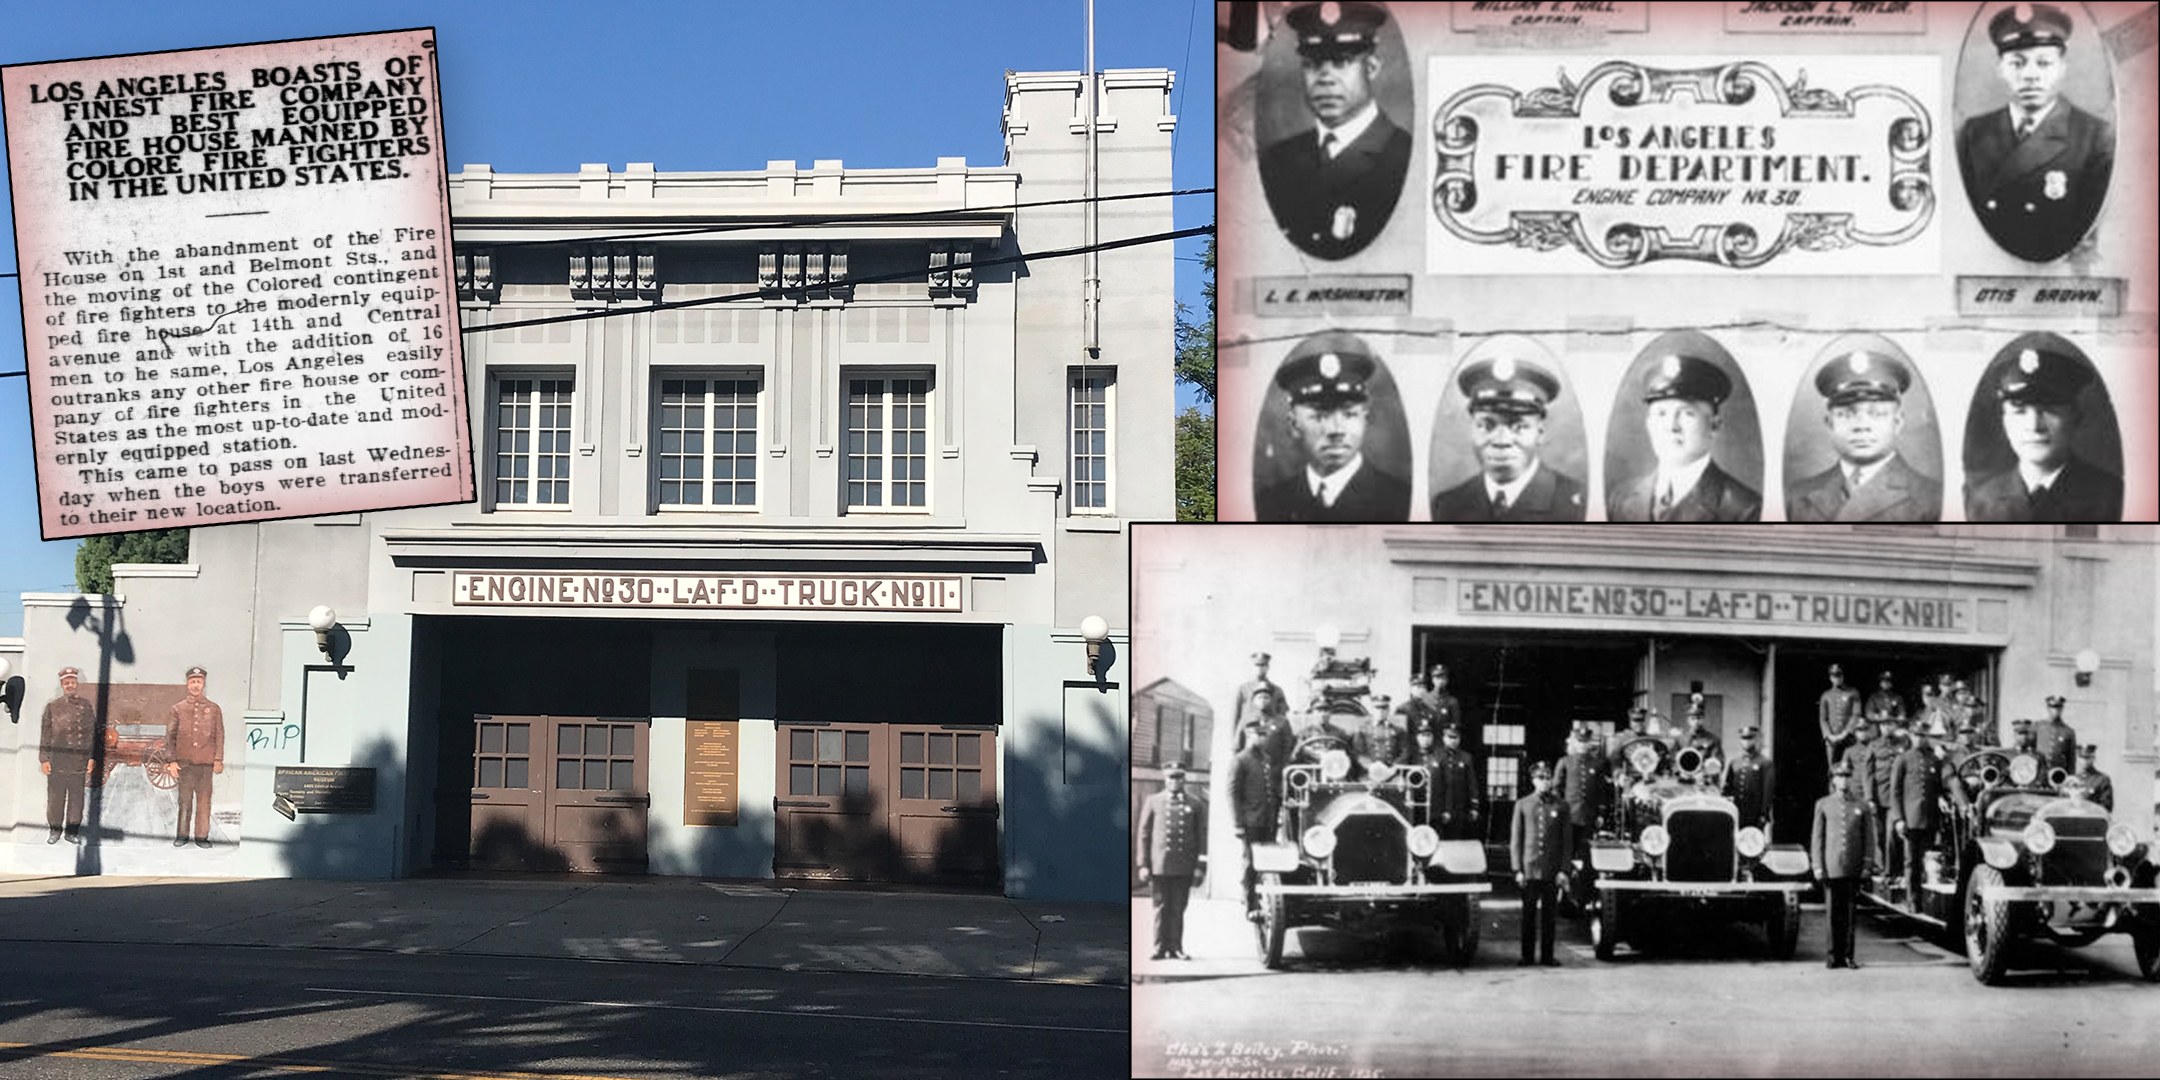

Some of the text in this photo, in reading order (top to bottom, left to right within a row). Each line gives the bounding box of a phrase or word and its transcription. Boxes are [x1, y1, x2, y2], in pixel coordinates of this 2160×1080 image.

[29, 56, 424, 104] LOS ANGELES BOASTS OF
[62, 76, 425, 122] FINEST FIRE COMPANY
[63, 96, 428, 142] AND BEST EQUIPPED
[65, 115, 429, 162] FIRE HOUSE MANNED BY
[1638, 125, 1776, 150] ANGELES
[65, 136, 431, 182] COLORE FIRE FIGHTERS
[1495, 154, 1871, 182] FIRE DEPARTMENT.
[68, 158, 411, 202] IN THE UNITED STATES.
[1571, 188, 1639, 205] ENGINE
[1645, 188, 1731, 206] COMPANY
[43, 271, 107, 287] House
[118, 269, 145, 283] on
[157, 264, 186, 280] 1st
[199, 260, 236, 277] and
[248, 255, 332, 273] Belmont
[401, 245, 437, 262] and
[63, 226, 436, 266] With the abandnment of the Fire
[44, 266, 440, 306] the moving of the Colored contingent
[45, 285, 441, 326] of fire fighters to the modernly equip-
[1974, 287, 2018, 303] OTIS
[47, 303, 441, 350] ped fire house at 14th and Central
[49, 324, 443, 367] avenue and with the addition of 16
[49, 373, 94, 387] men
[104, 371, 125, 384] to
[237, 359, 274, 374] Los
[284, 351, 365, 371] Angeles
[386, 344, 444, 362] easily
[51, 367, 446, 406] outranks any other fire house or com-
[53, 382, 447, 428] pany of fire fighters in the United
[54, 402, 449, 445] States as the most up-to-date and mod-
[55, 436, 297, 466] ernly equipped station.
[78, 445, 451, 485] This came to pass on last Wednes-
[59, 462, 452, 508] day when the boys were transferred
[60, 499, 281, 526] to their new location.
[777, 579, 883, 607] TRUCK
[1792, 593, 1894, 625] TRUCK
[247, 724, 300, 750] RIP
